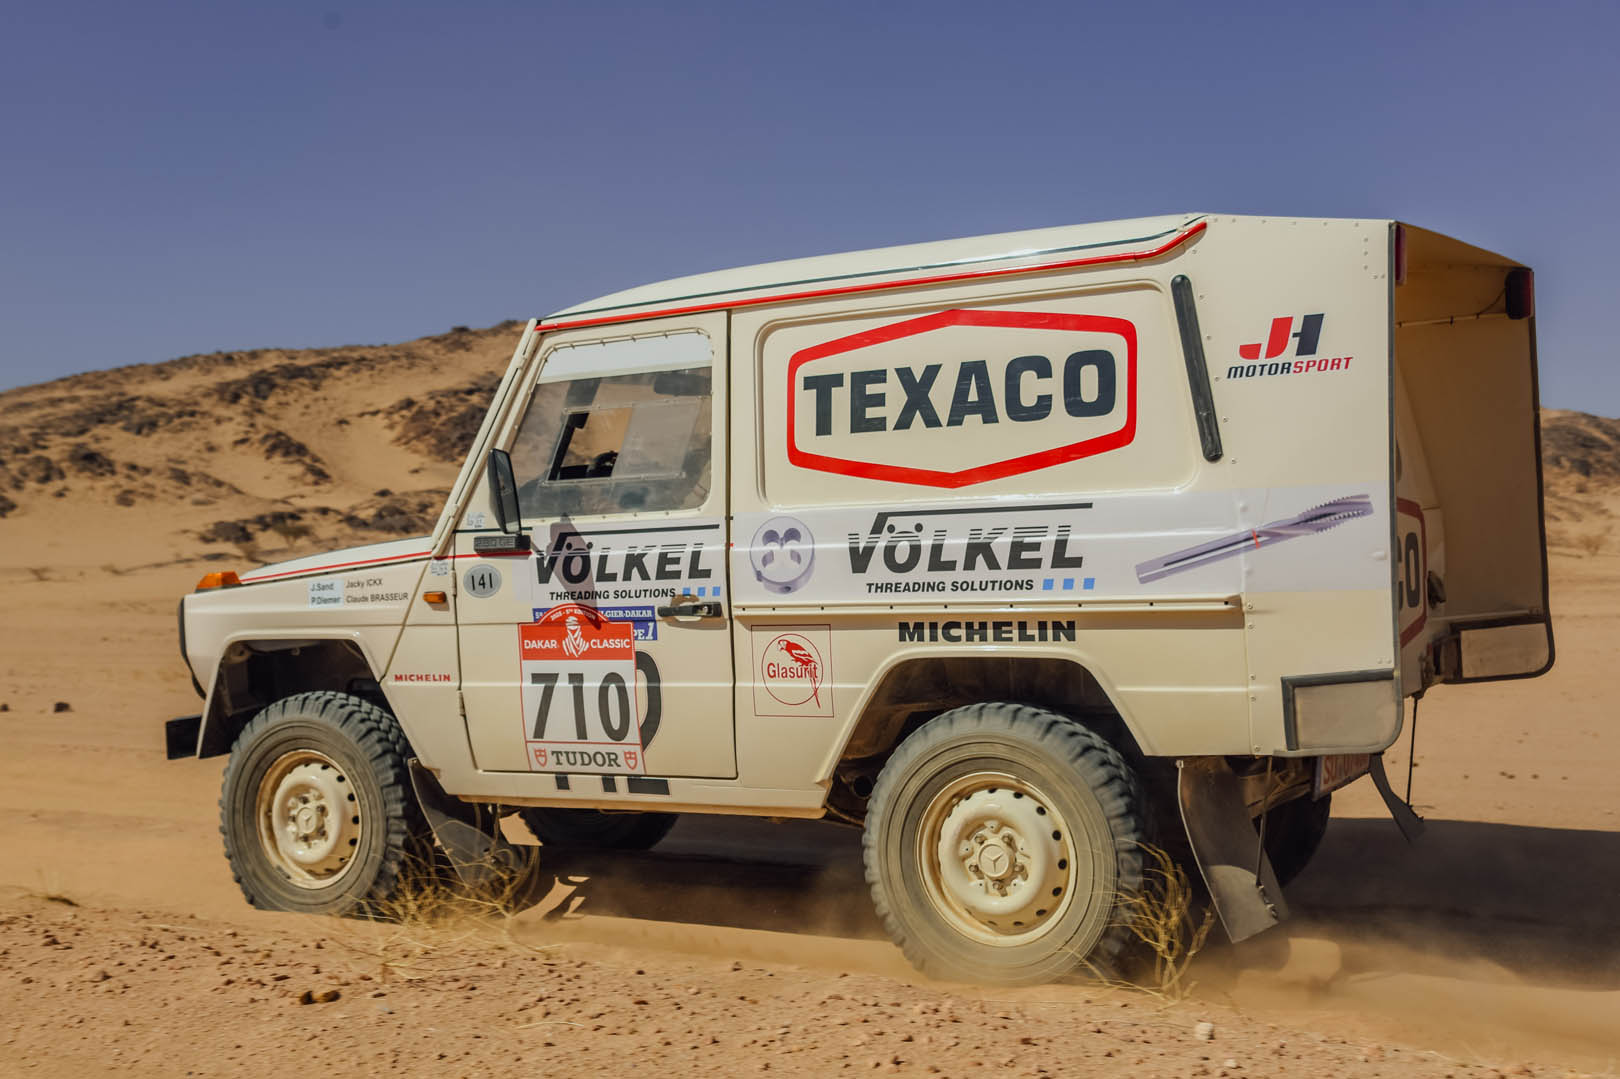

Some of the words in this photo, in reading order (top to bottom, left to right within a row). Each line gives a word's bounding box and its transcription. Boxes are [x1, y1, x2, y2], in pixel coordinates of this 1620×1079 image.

[1227, 357, 1353, 379] MOTORSPORT
[803, 349, 1117, 437] TEXACO
[848, 503, 1093, 574] VÖLKEL
[535, 524, 720, 584] VÖLKEL
[345, 579, 365, 589] Jacky
[471, 572, 493, 591] 141
[866, 580, 946, 594] THREADING
[950, 578, 1034, 592] SOLUTIONS
[370, 592, 409, 602] BRASSEUR
[550, 590, 610, 601] THREADING
[613, 588, 676, 600] SOLUTIONS
[898, 620, 1077, 643] MICHELIN
[524, 639, 558, 649] DAKAR
[590, 638, 631, 649] CLASSIC
[394, 673, 451, 682] MICHELIN
[767, 662, 818, 679] Glasurit
[531, 672, 631, 742] 710
[551, 750, 621, 768] TUDOR
